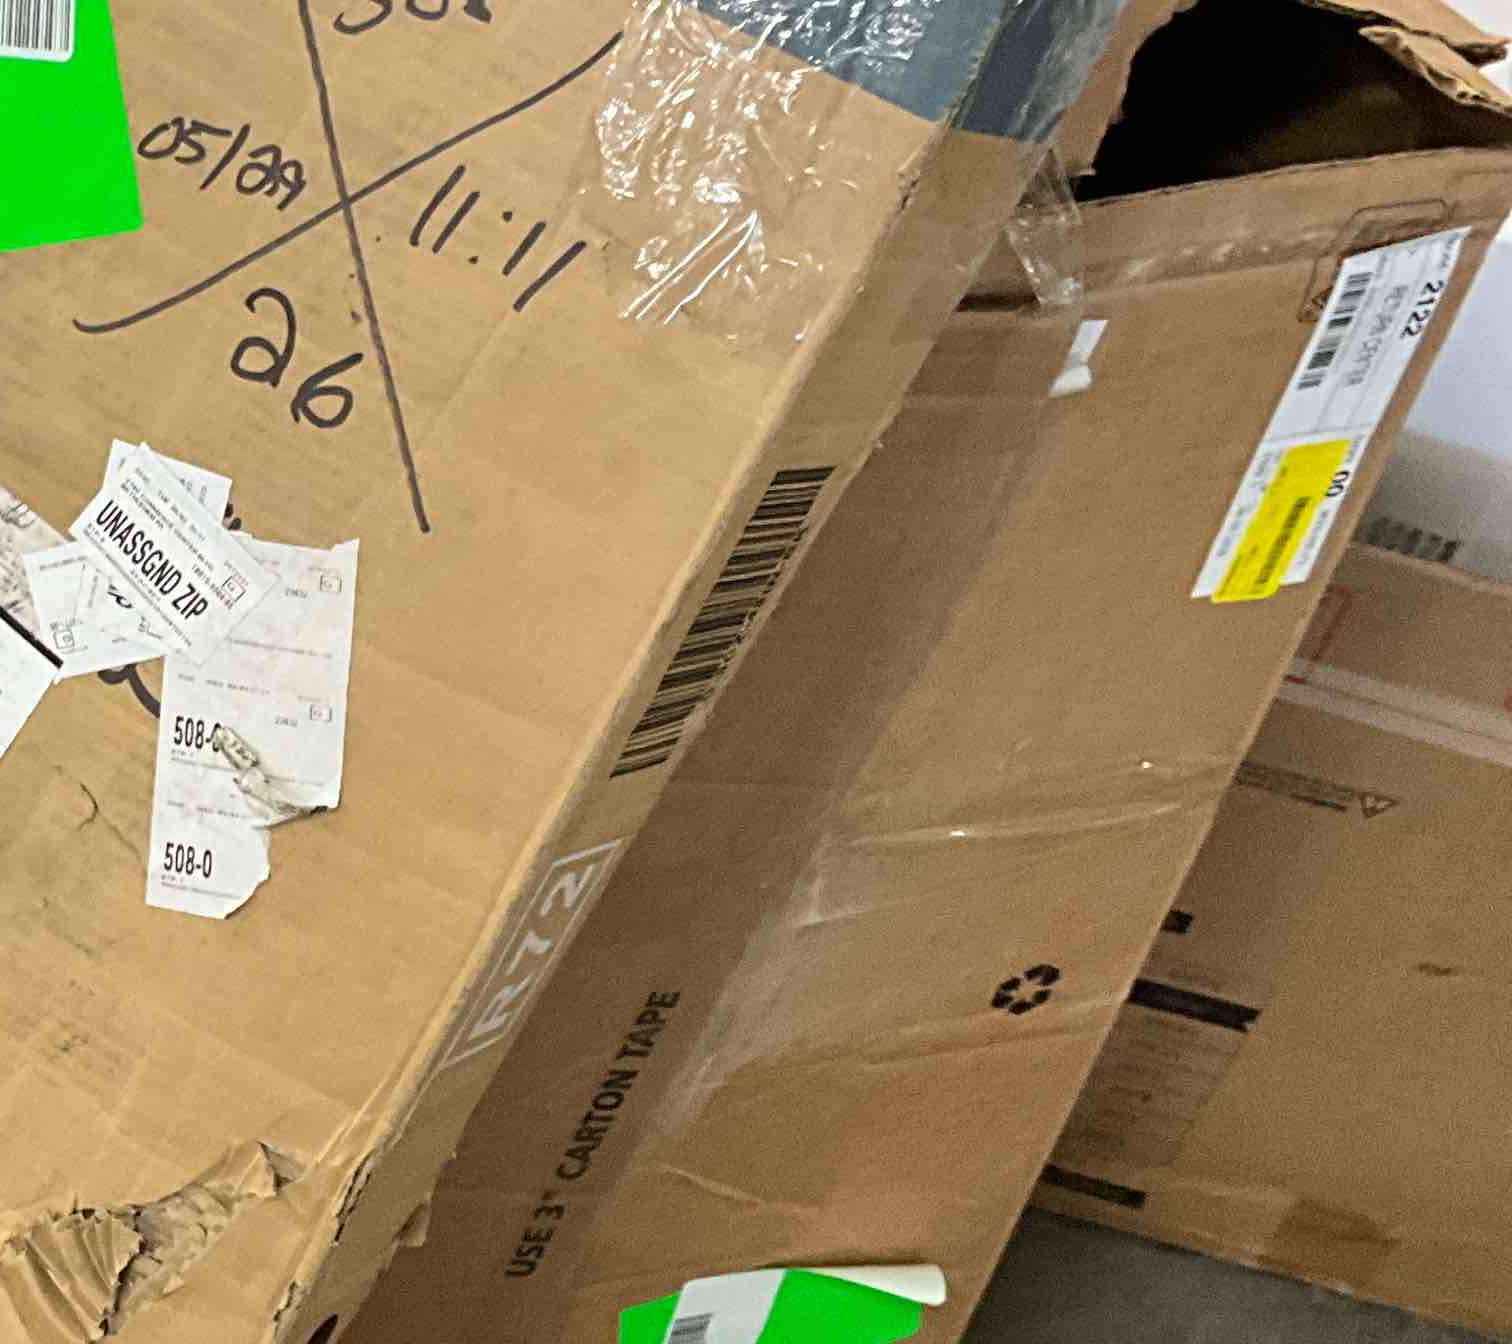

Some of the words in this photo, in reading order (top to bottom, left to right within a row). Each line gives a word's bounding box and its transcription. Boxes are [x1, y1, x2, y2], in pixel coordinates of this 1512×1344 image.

[409, 164, 588, 312] 11:11
[230, 288, 364, 428] 26
[1399, 277, 1445, 341] 2122
[95, 499, 183, 596] UNASSGND
[172, 582, 209, 620] ZIP
[163, 842, 213, 878] 508-0
[505, 1218, 555, 1281] USE
[555, 1069, 639, 1182] CARTON
[619, 991, 680, 1063] TAPE
